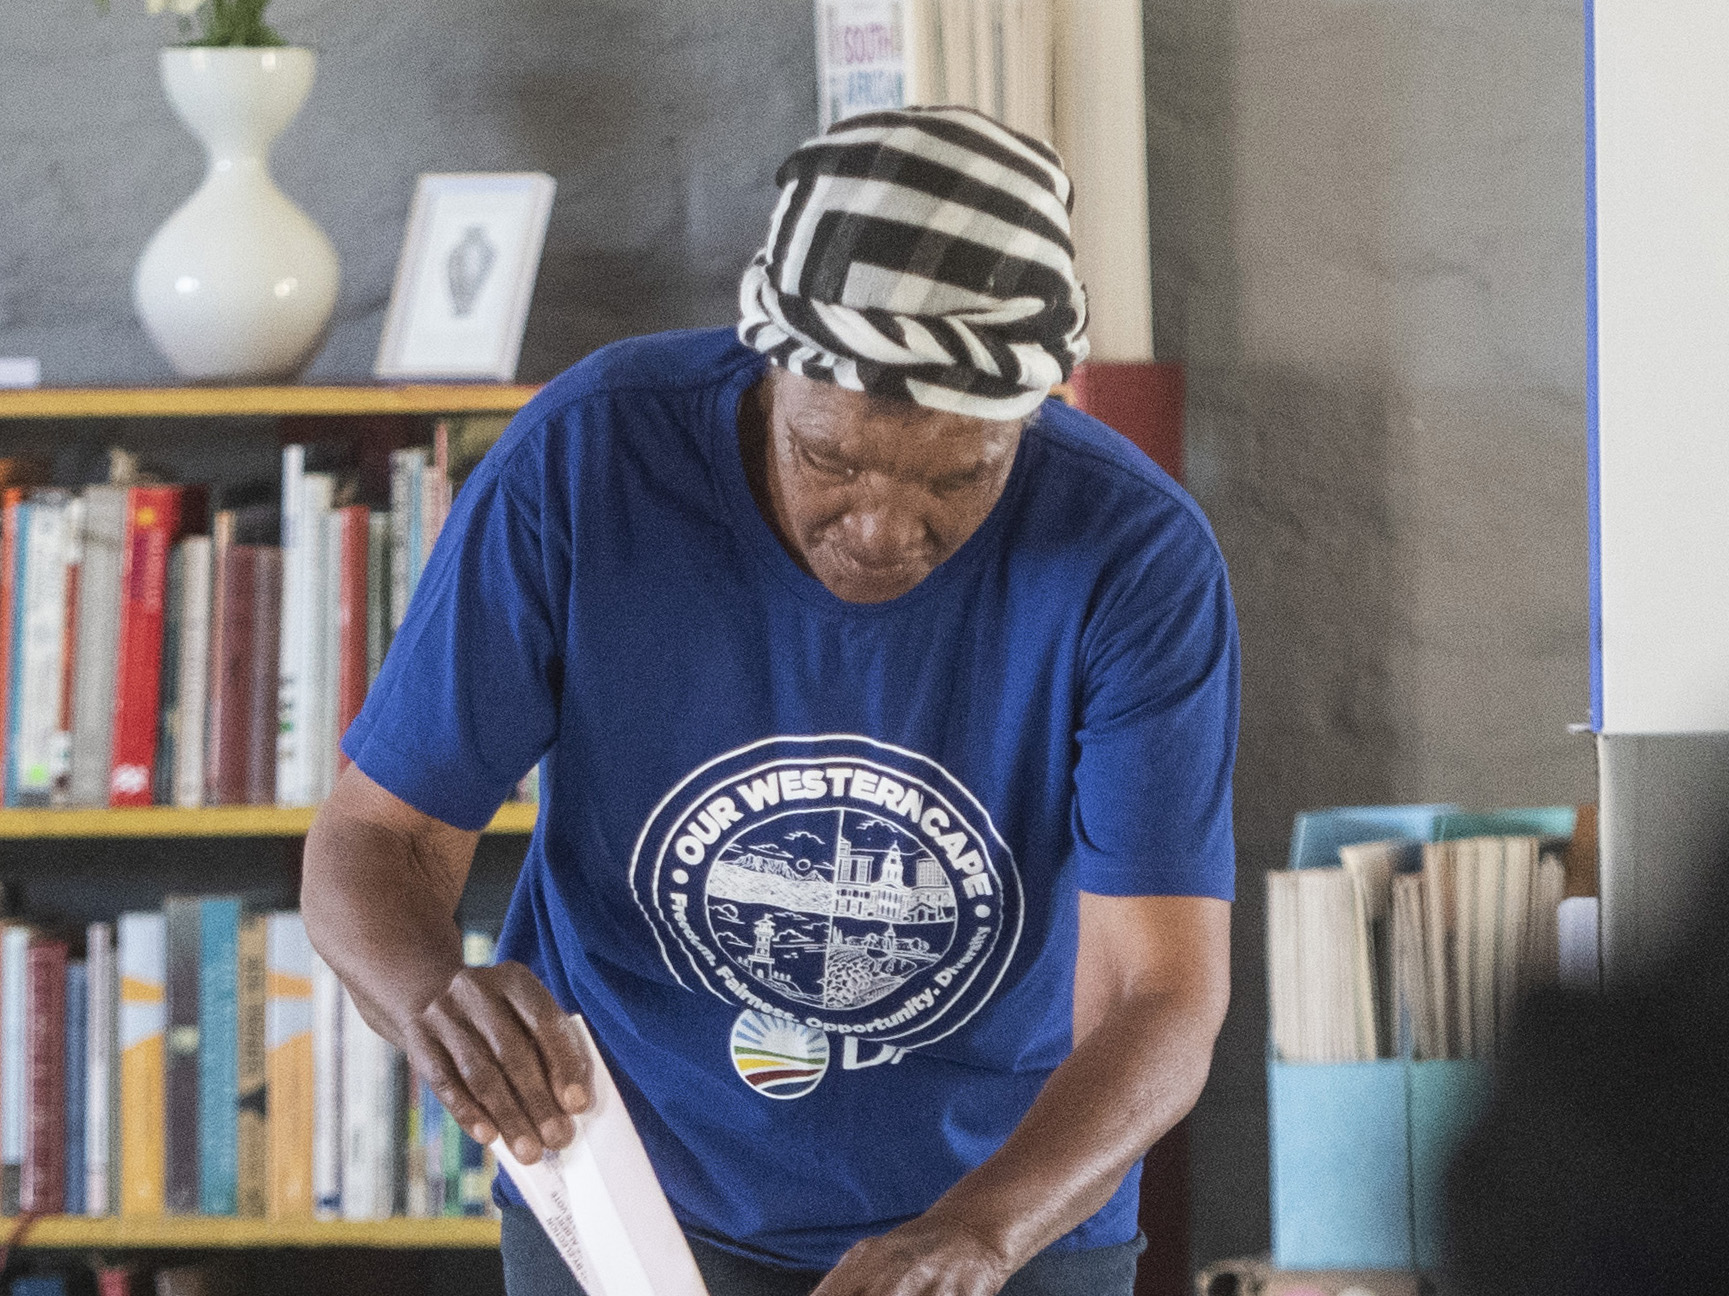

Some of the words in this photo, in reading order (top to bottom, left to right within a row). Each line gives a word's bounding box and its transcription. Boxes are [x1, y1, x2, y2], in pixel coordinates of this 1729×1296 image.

[675, 795, 743, 866] OUR
[738, 768, 925, 824] WESTERN
[919, 806, 991, 899] CAPE
